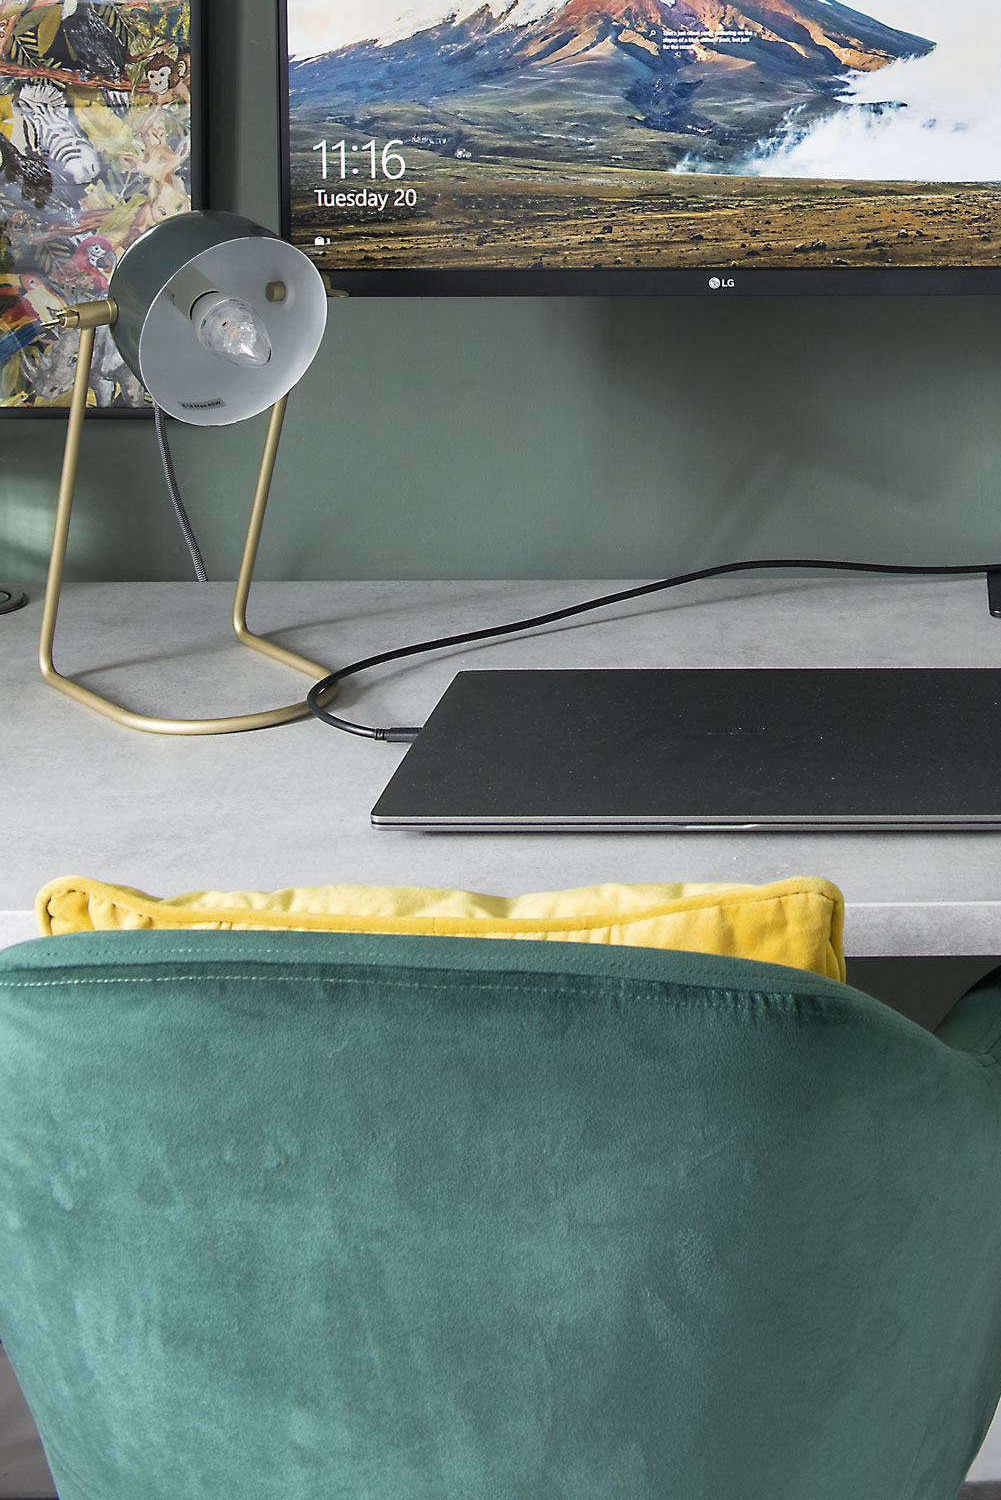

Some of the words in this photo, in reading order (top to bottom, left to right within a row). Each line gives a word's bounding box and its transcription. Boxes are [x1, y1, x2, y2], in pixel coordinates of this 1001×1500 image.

[312, 139, 406, 180] 11:16
[313, 188, 389, 211] Tuesday
[393, 188, 417, 207] 20
[721, 278, 735, 288] LG
